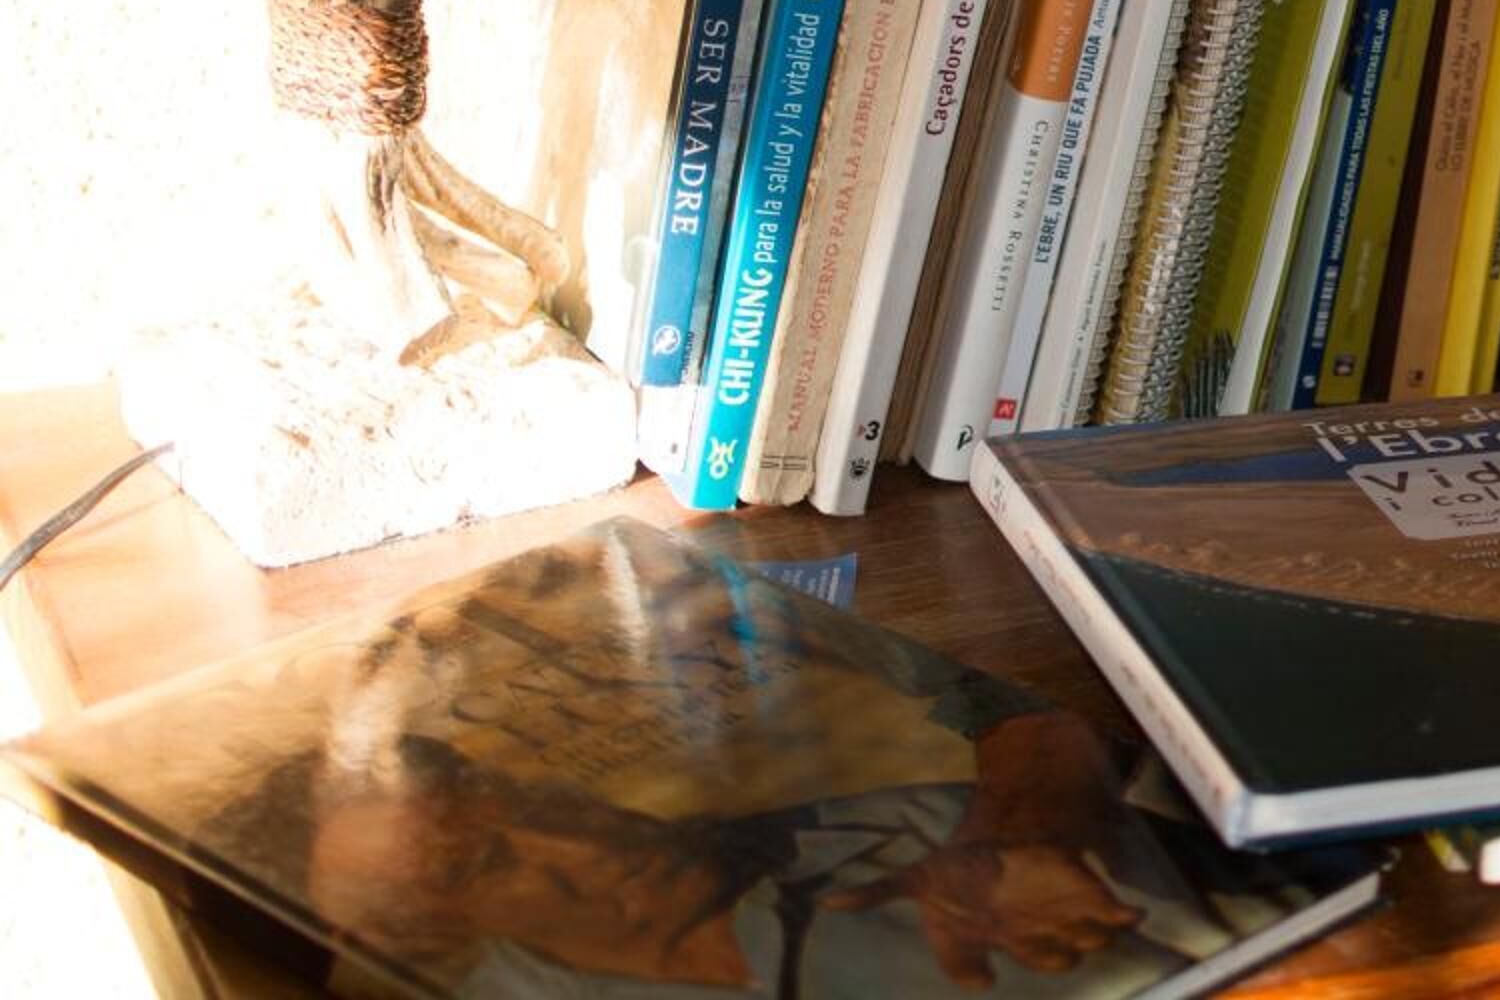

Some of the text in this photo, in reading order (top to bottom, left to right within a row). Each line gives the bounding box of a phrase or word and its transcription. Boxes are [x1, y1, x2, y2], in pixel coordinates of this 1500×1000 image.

[925, 26, 966, 137] Caçadors
[954, 0, 975, 28] de
[1077, 35, 1102, 92] PUJADA
[1070, 94, 1088, 116] FA
[671, 18, 730, 236] SER MADRE
[1062, 120, 1082, 151] QUE
[1054, 152, 1073, 181] RIU
[718, 12, 820, 406] CHI-KUNG para la salud y la vitalidad
[1050, 183, 1067, 207] UN
[787, 350, 817, 432] MANUAL
[809, 244, 840, 339] MODERNO
[830, 188, 856, 238] PARA
[856, 10, 892, 150] FABRICACION
[1034, 209, 1062, 264] L'EBRE,
[864, 420, 881, 441] 3
[1303, 415, 1440, 438] Terres
